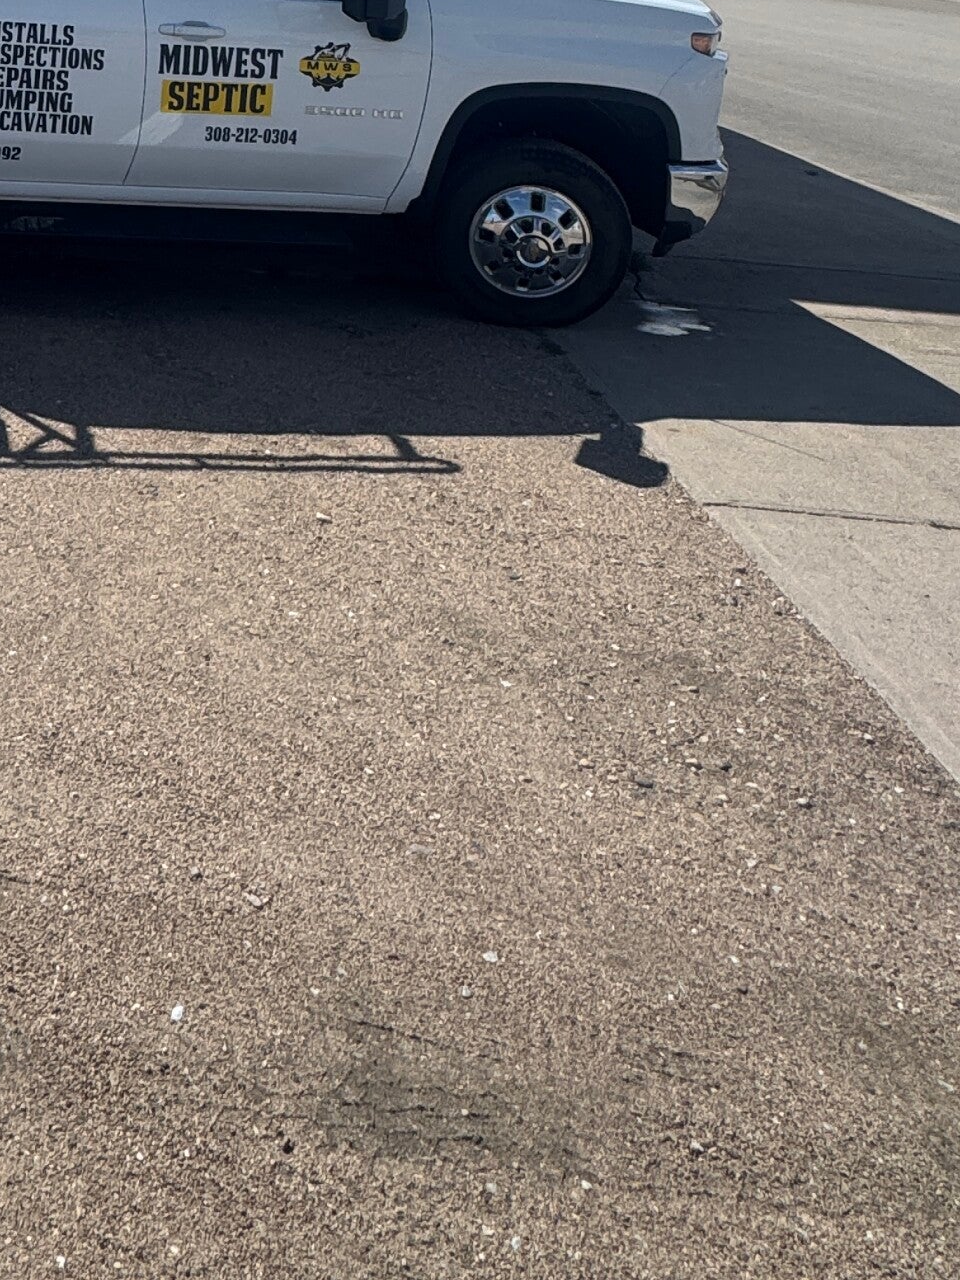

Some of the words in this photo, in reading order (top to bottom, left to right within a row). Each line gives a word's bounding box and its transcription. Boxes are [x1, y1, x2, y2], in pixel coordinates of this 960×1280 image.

[158, 43, 284, 80] MIDWEST
[167, 81, 267, 114] SEPTIC
[204, 126, 297, 145] 308-212-0304
